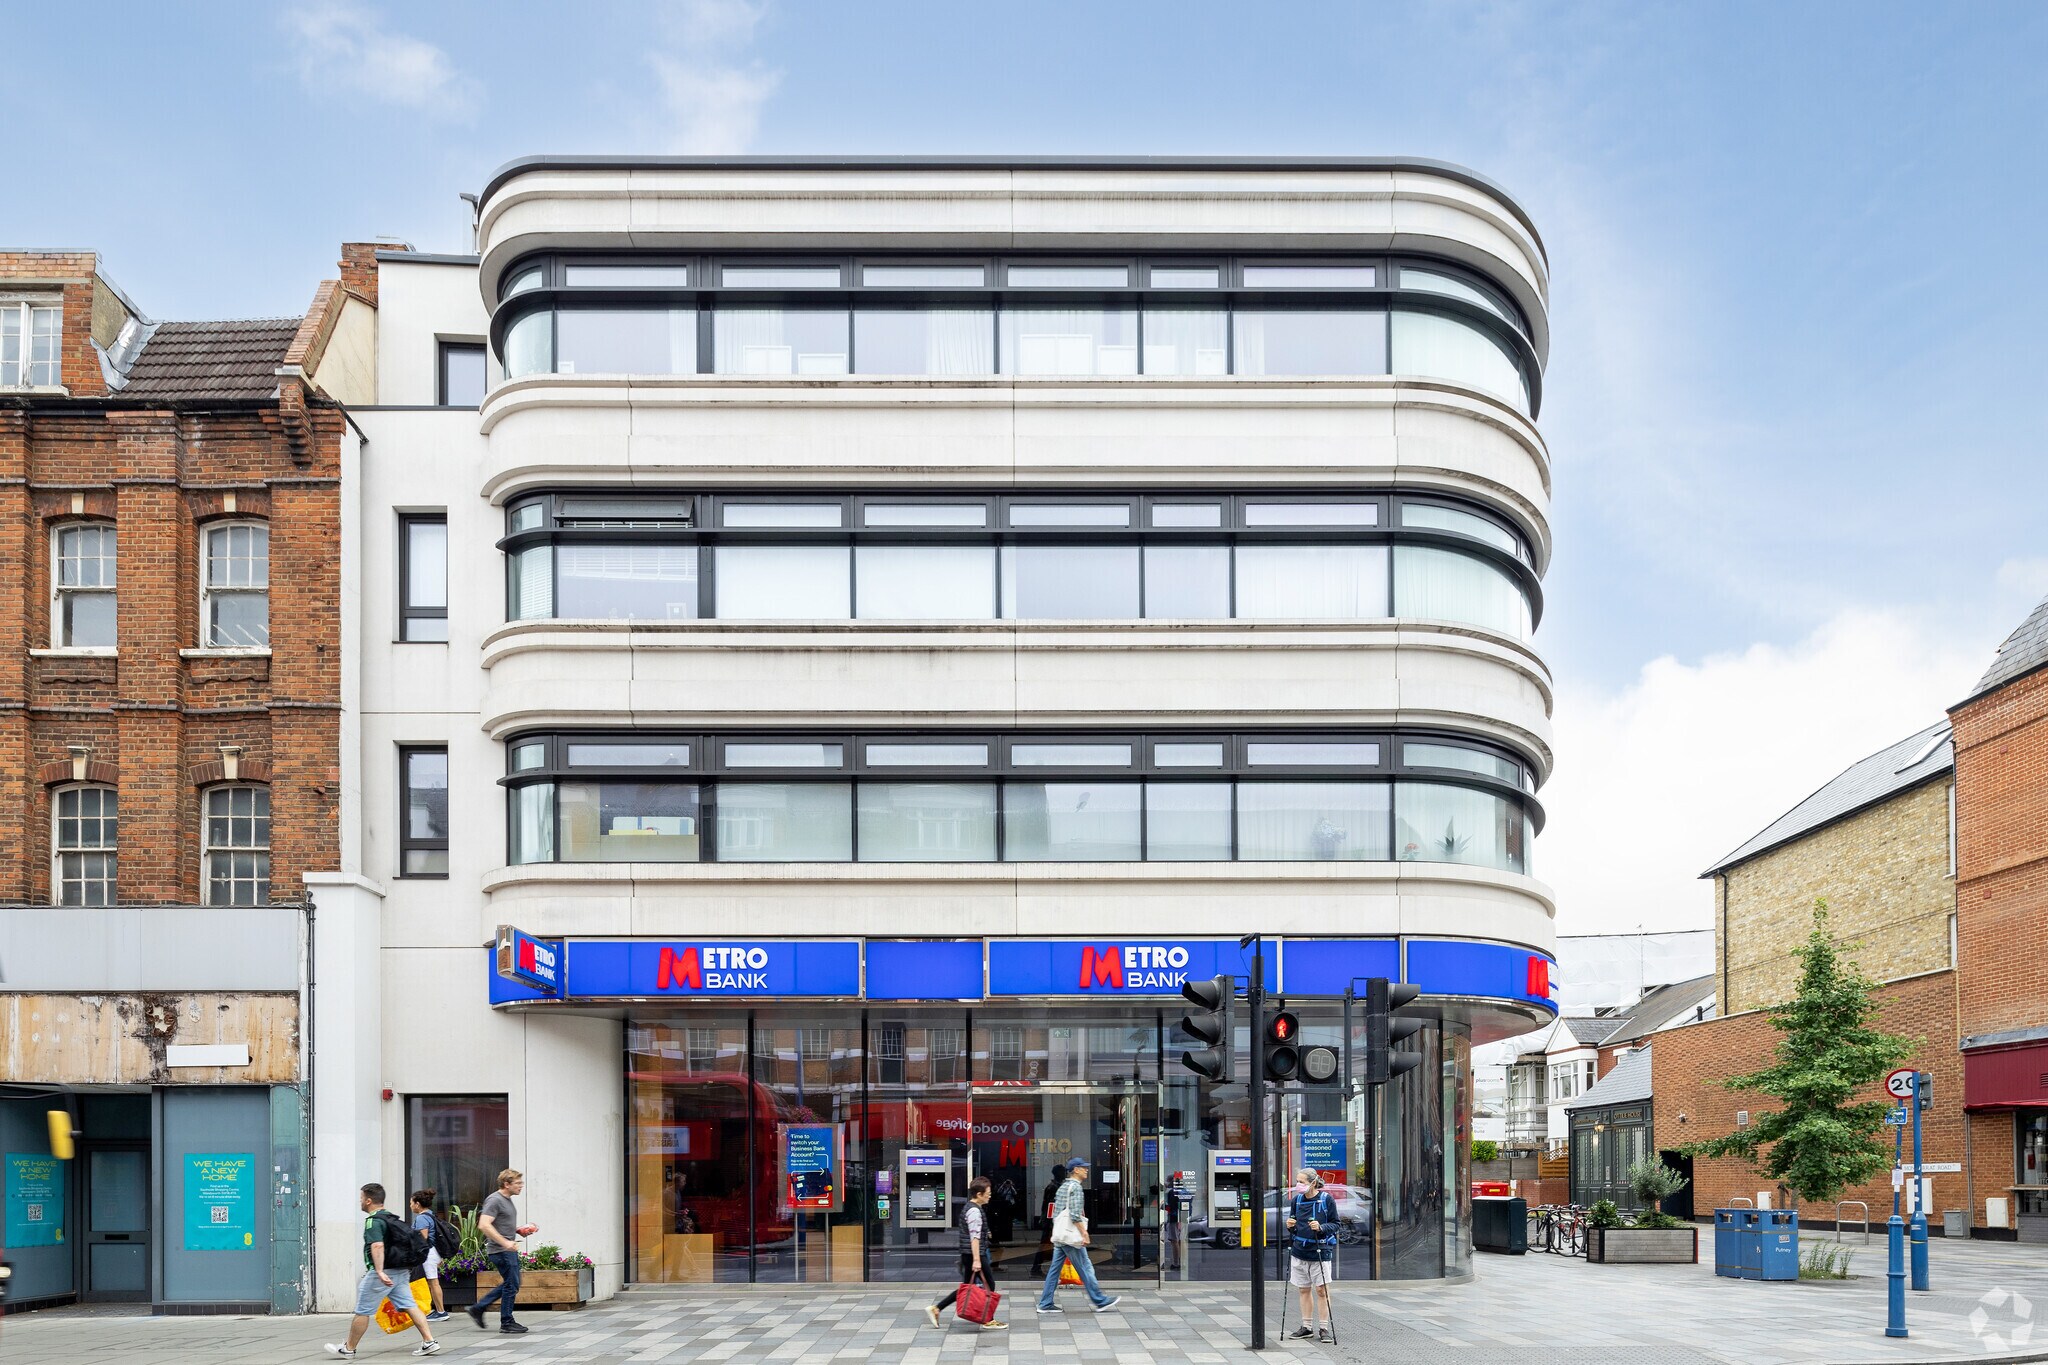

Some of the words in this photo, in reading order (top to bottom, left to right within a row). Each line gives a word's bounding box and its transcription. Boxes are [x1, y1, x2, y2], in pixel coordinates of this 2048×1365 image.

[519, 938, 555, 973] METRO
[657, 942, 768, 988] METRO
[1079, 946, 1189, 988] METRO
[535, 962, 555, 981] BANK
[706, 973, 768, 988] BANK
[1128, 972, 1188, 988] BANK
[1000, 1138, 1072, 1167] METRO
